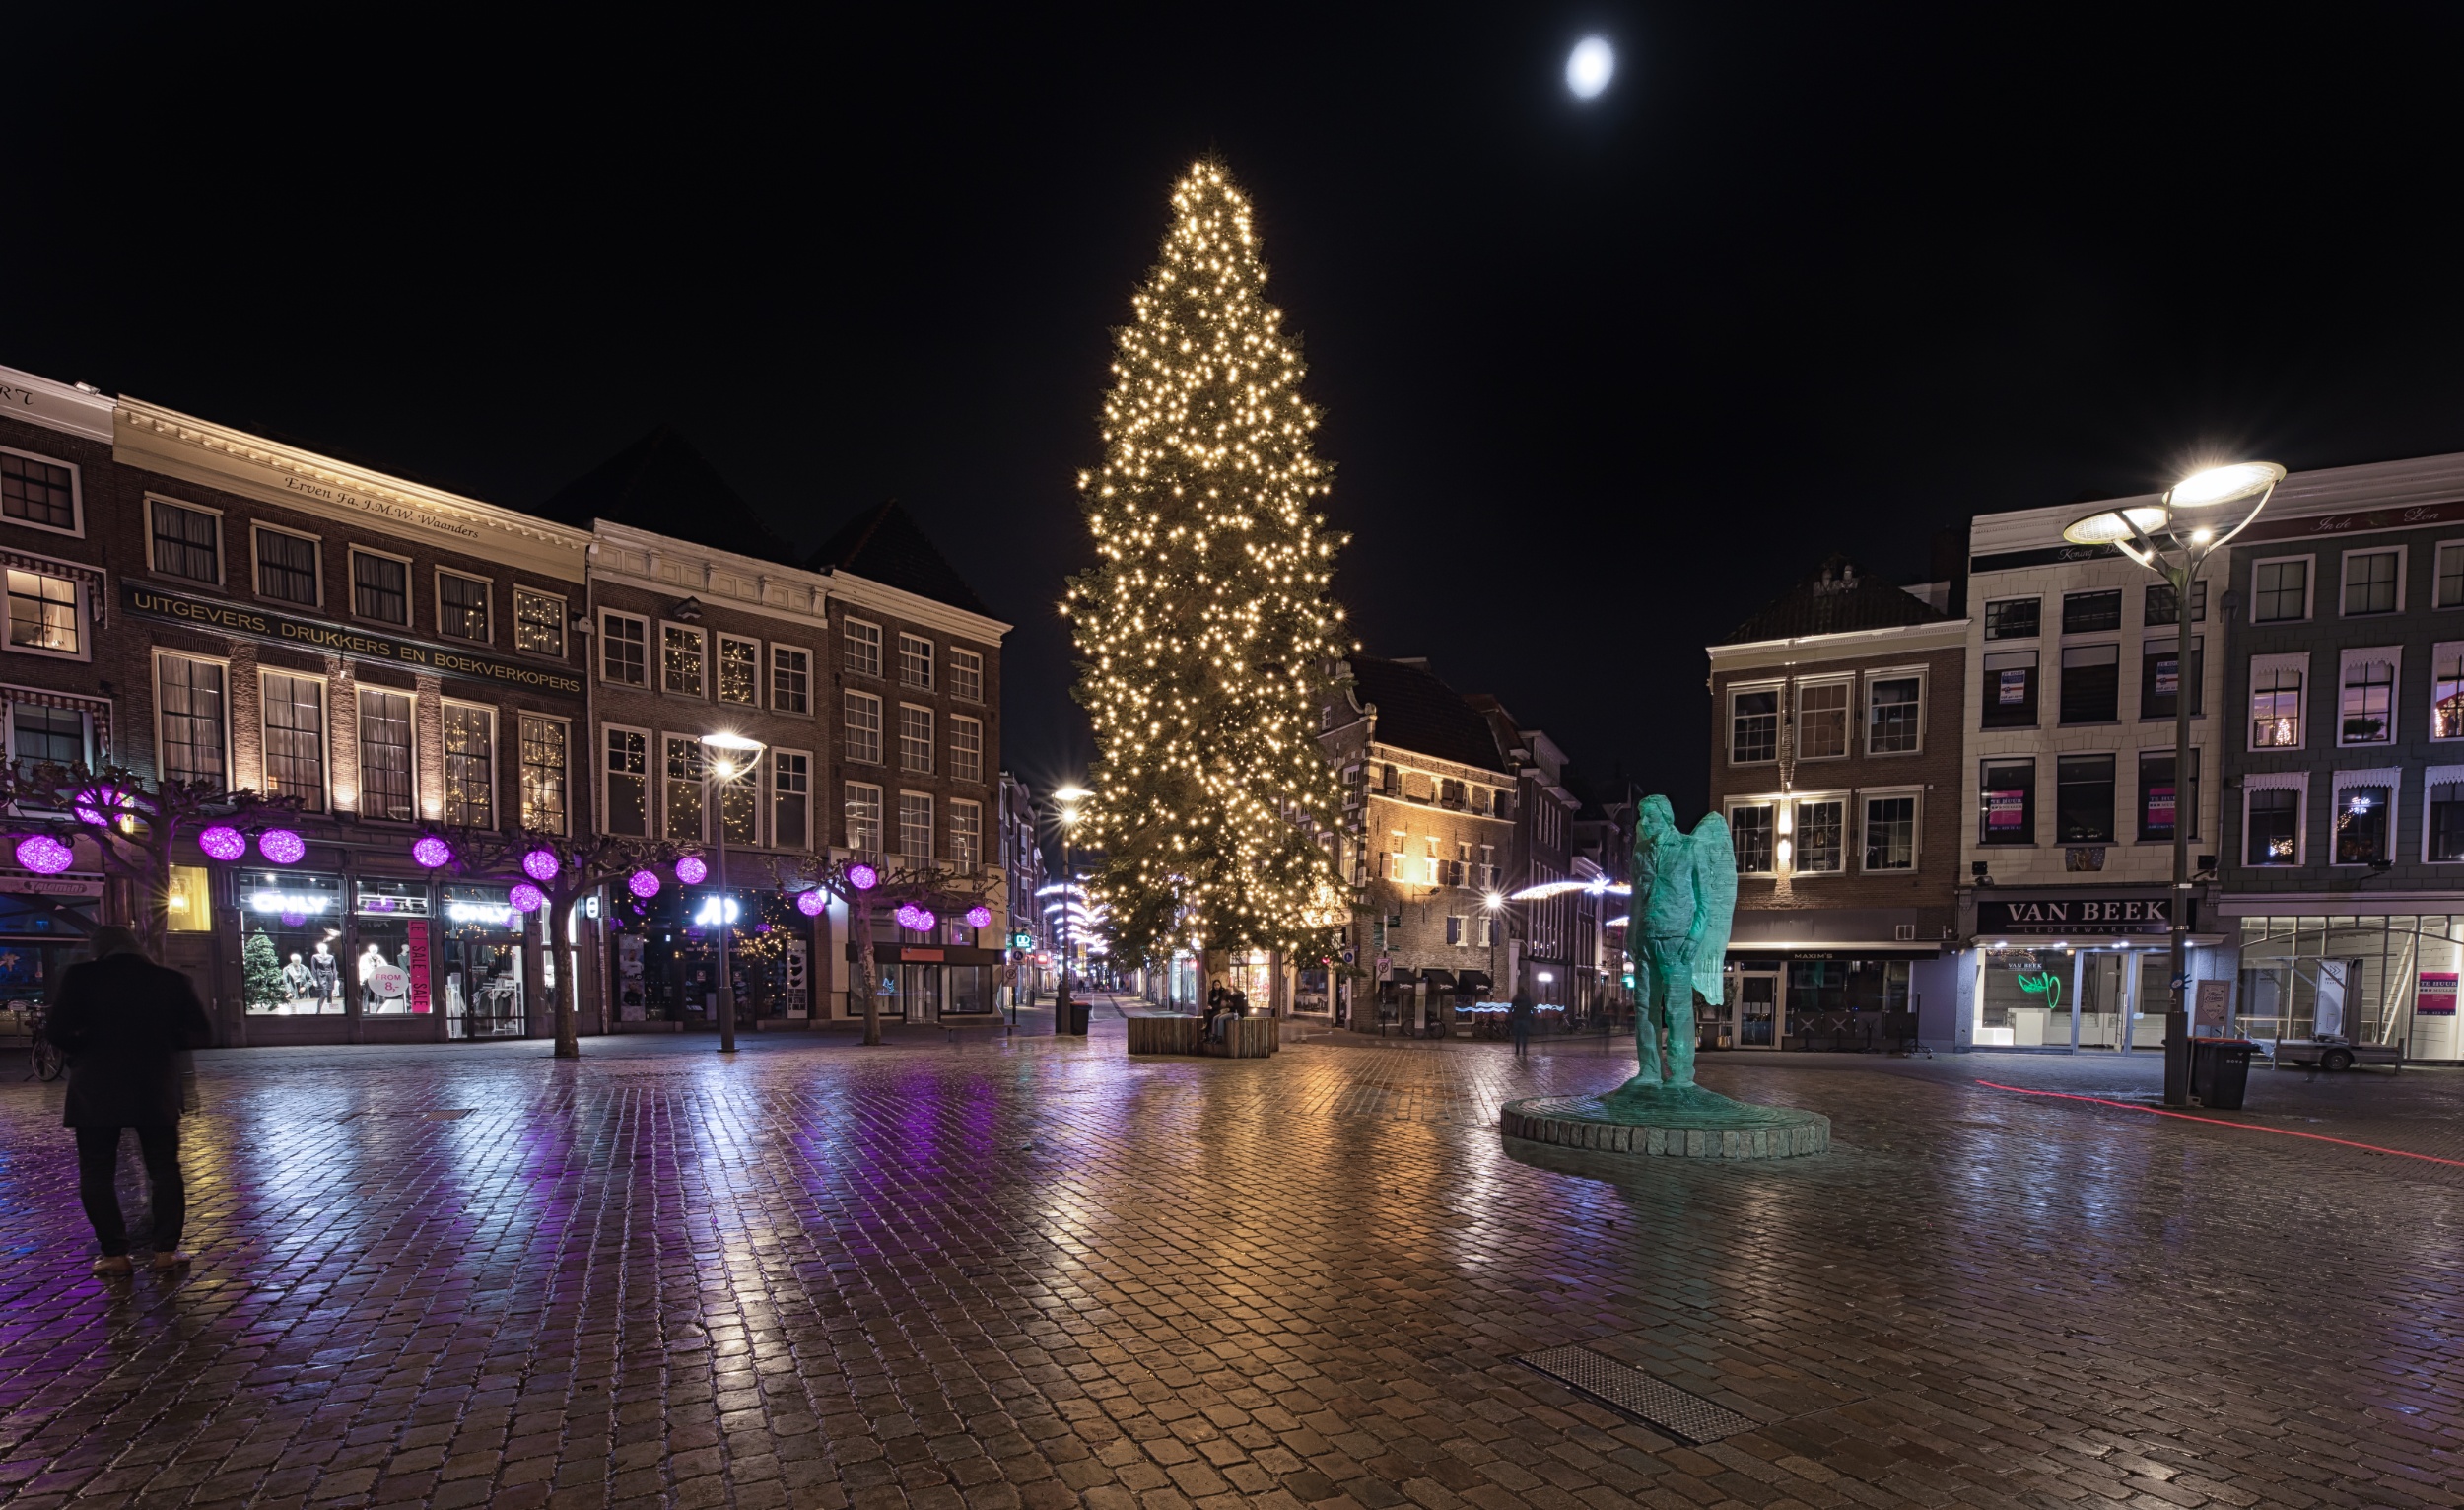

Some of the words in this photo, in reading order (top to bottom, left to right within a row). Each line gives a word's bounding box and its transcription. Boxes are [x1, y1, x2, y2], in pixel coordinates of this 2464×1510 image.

[284, 477, 332, 499] Erven
[337, 492, 359, 507] Fa.
[418, 514, 479, 539] Waanders
[2310, 515, 2334, 532] In
[2335, 517, 2352, 529] de
[2403, 507, 2439, 522] Zon
[2058, 547, 2093, 561] Koning
[134, 592, 271, 635] UITGEVERS,
[281, 623, 390, 655] DRUKKERS
[400, 646, 426, 663] EN
[434, 652, 580, 692] BOEKVERKOPERS
[251, 892, 329, 914] ONLY
[450, 904, 512, 922] ONLY
[2007, 902, 2069, 921] VAN
[2081, 901, 2165, 921] BEEK
[411, 945, 427, 970] SALE
[384, 981, 400, 992] 8,-
[413, 983, 428, 1006] SALE
